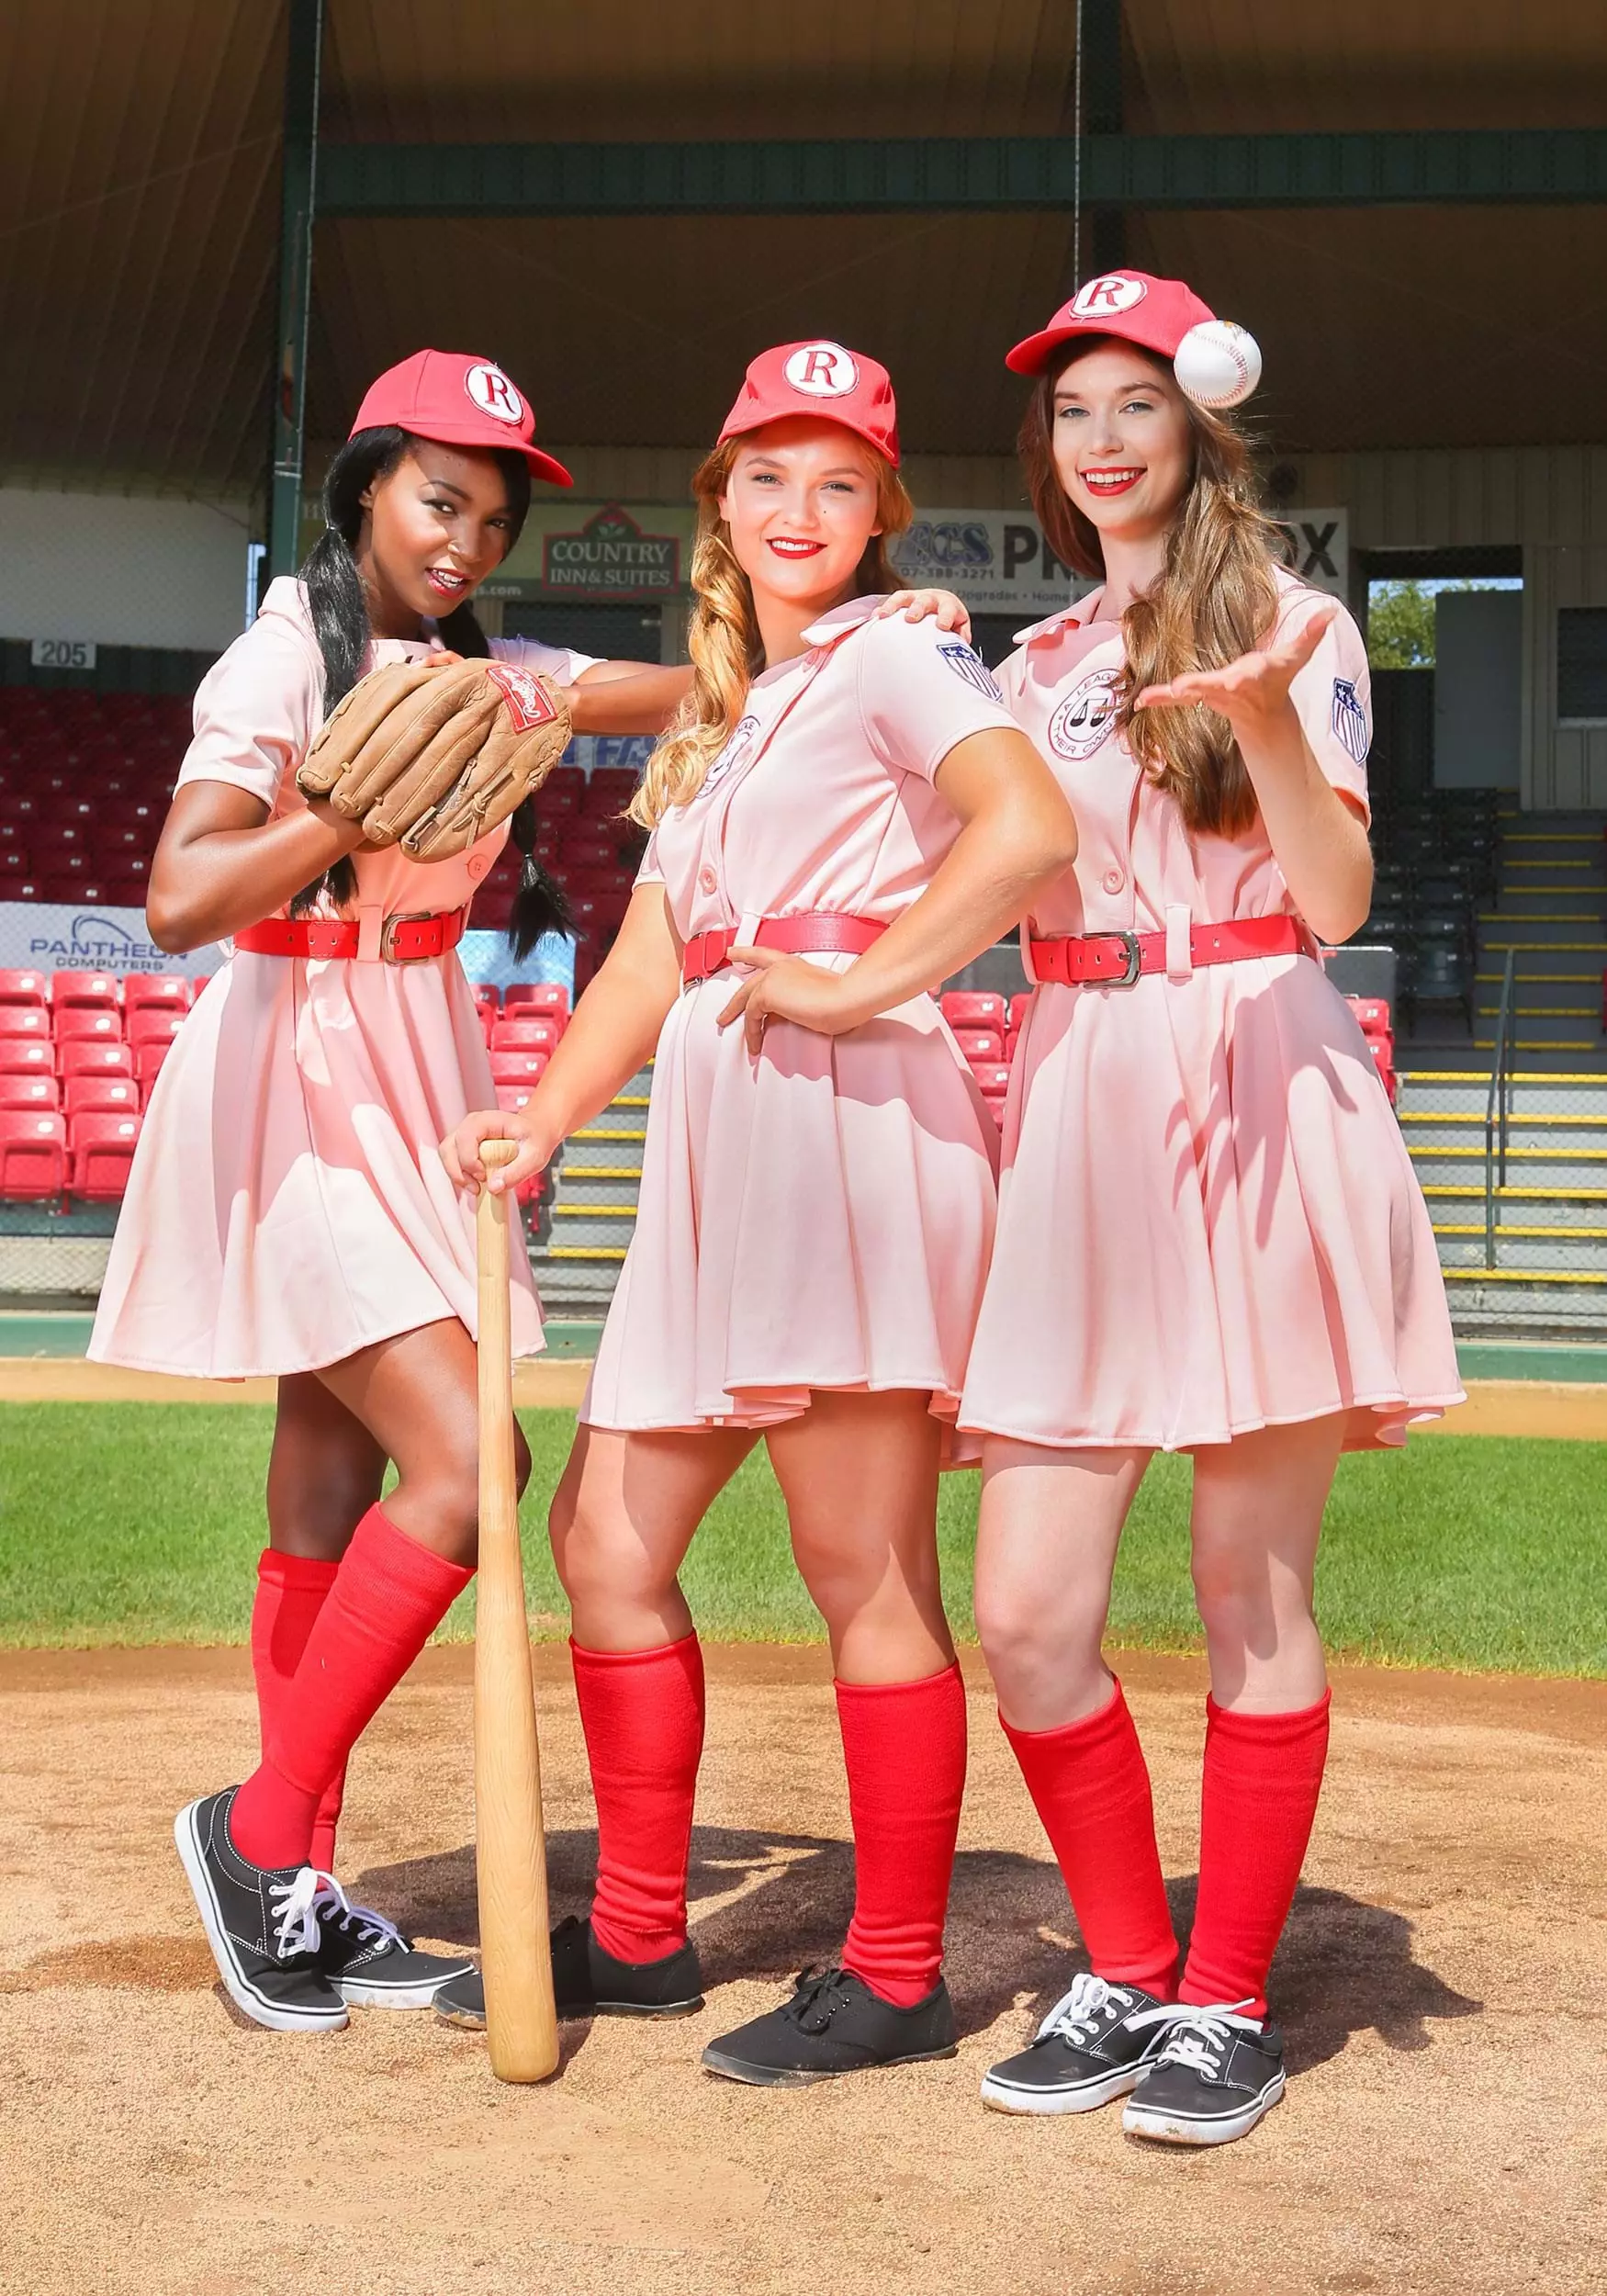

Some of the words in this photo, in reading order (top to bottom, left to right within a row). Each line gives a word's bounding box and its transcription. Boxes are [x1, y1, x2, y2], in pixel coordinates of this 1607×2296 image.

[1082, 280, 1125, 309] R
[799, 350, 837, 388] R
[481, 370, 517, 414] R
[552, 541, 670, 565] COUNTRY
[604, 569, 671, 587] SUITES
[40, 640, 87, 668] 205
[29, 939, 188, 960] PANTHEO
[56, 956, 164, 971] COMPUTERS
